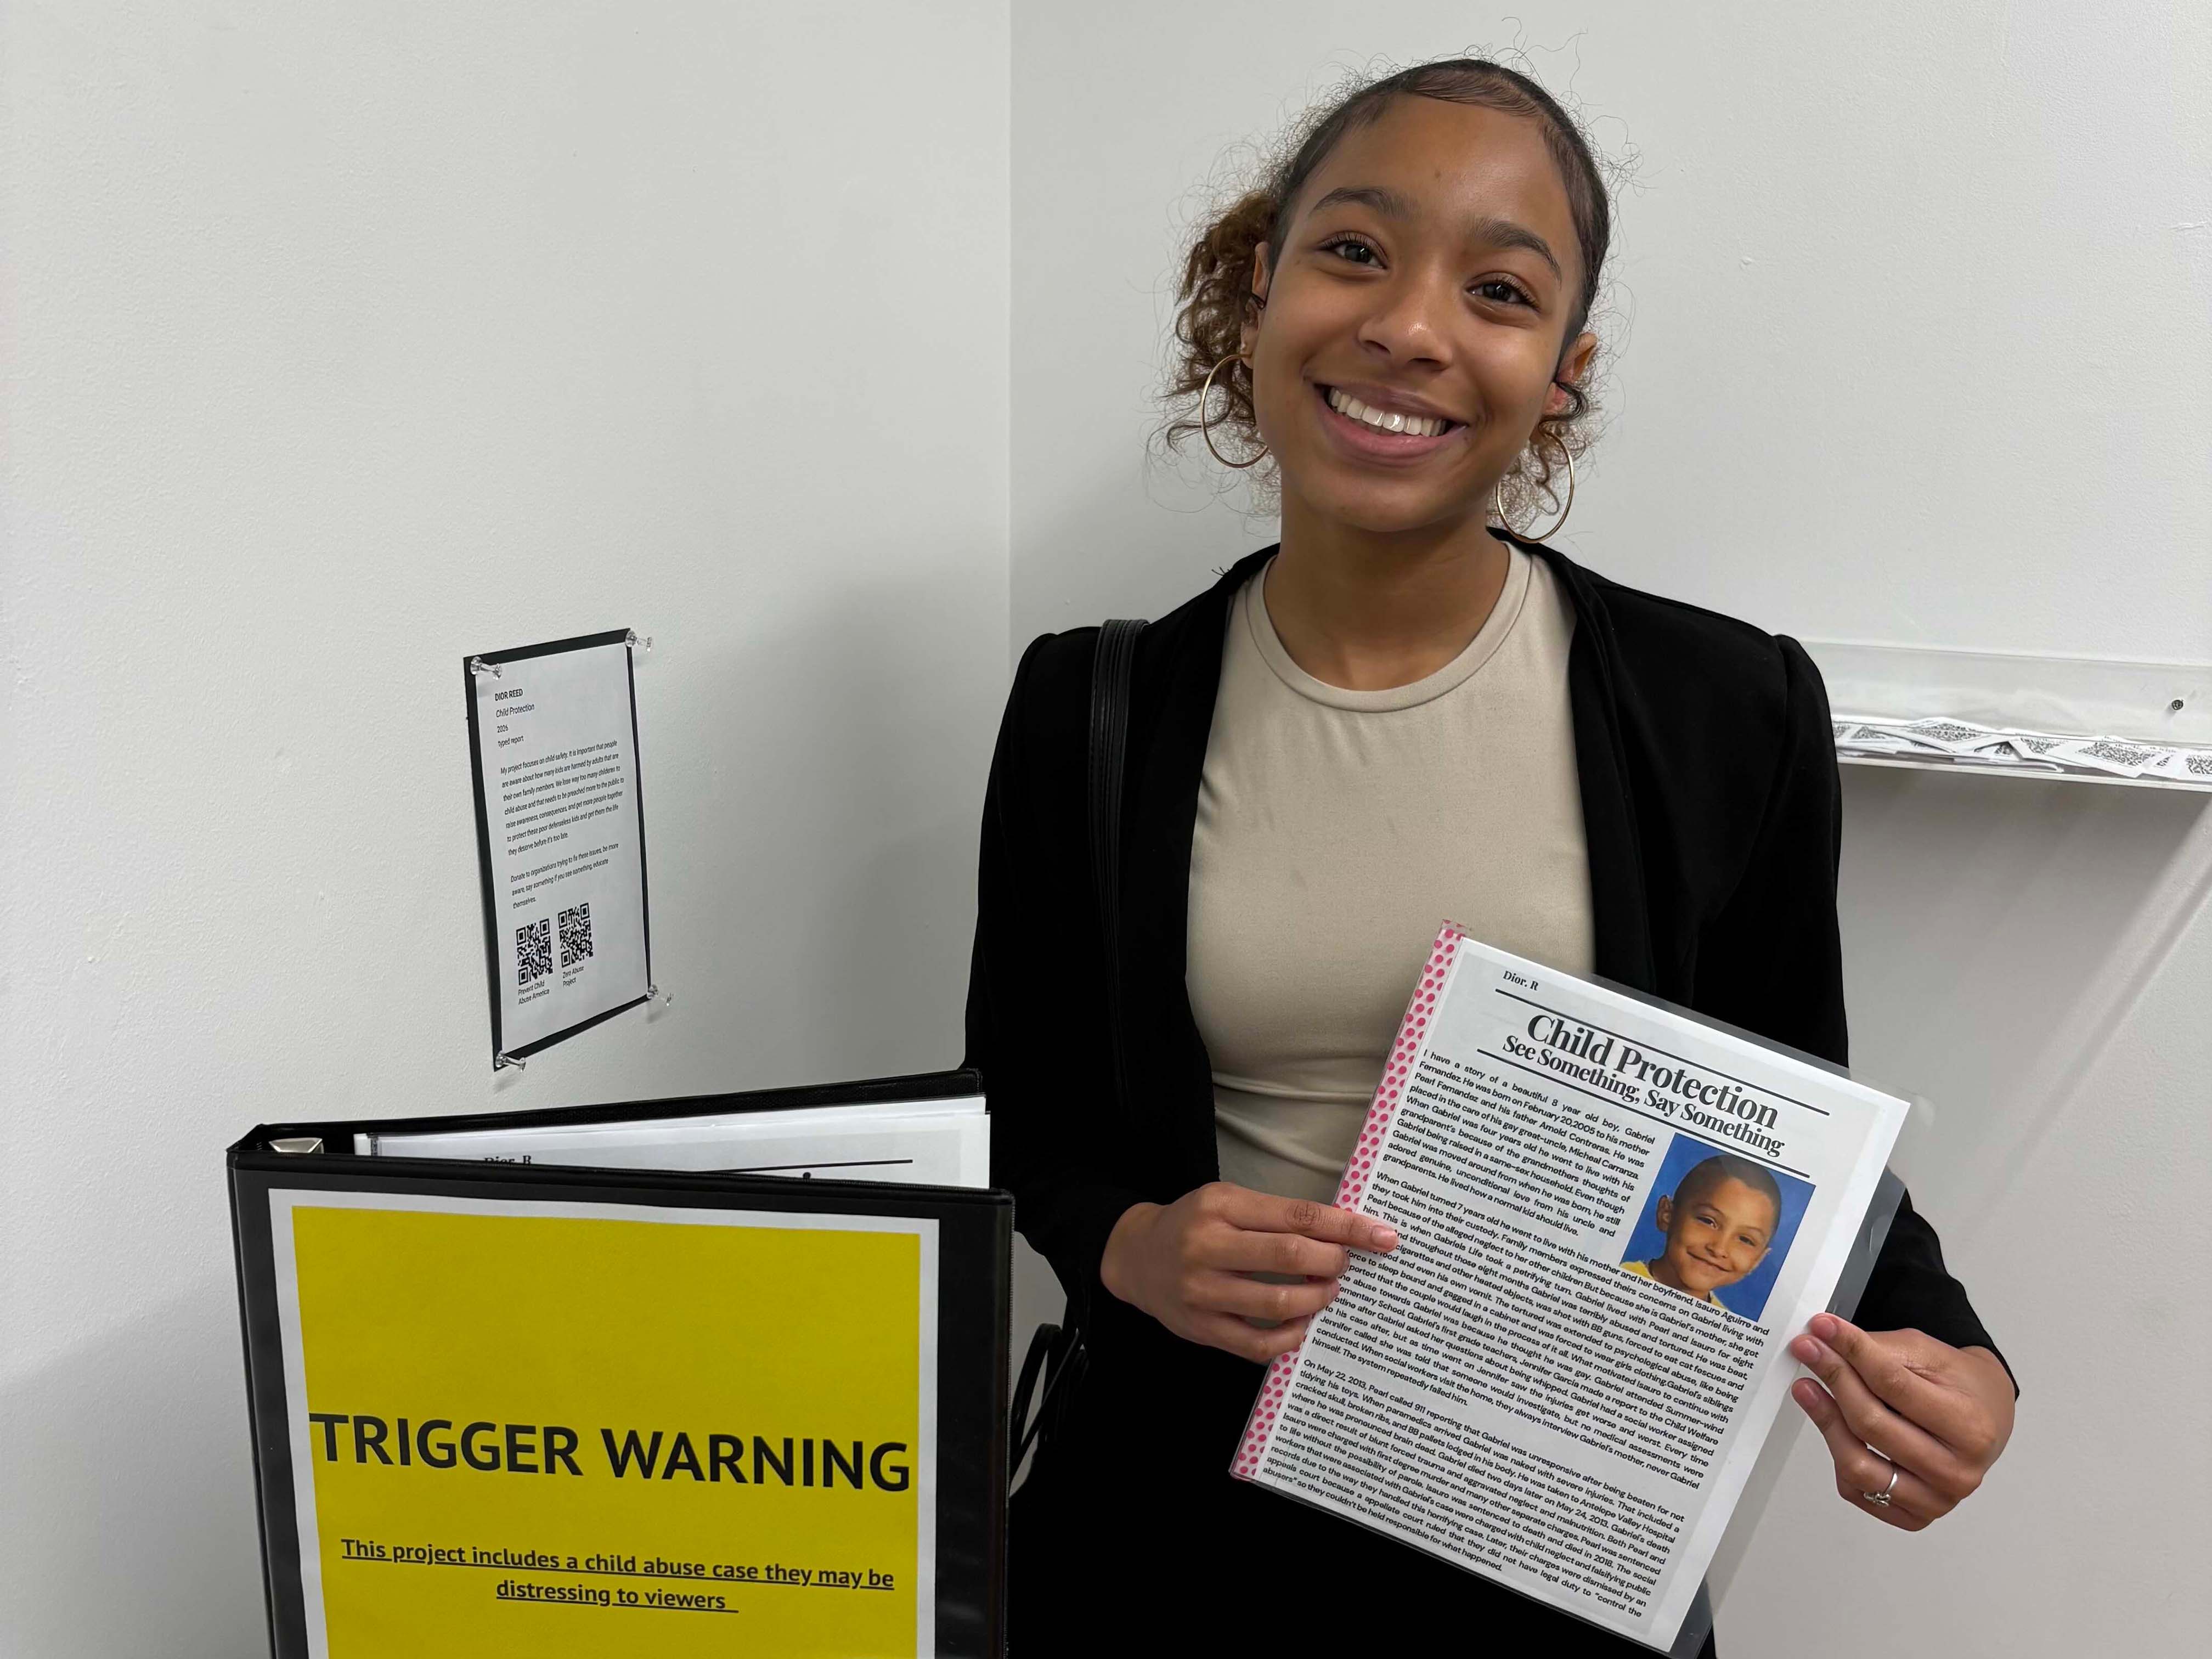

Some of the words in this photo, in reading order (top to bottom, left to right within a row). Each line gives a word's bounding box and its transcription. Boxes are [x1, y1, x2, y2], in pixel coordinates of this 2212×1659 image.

[494, 691, 509, 702] DIOR
[509, 688, 523, 698] REED
[495, 707, 509, 718] Child
[509, 703, 535, 715] Protection
[498, 737, 511, 749] typed
[510, 735, 524, 745] report
[500, 766, 507, 776] My
[507, 763, 522, 774] project
[522, 759, 539, 769] focuses
[545, 753, 555, 764] child
[576, 745, 596, 755] important
[596, 743, 604, 751] that
[603, 740, 618, 750] people
[504, 805, 515, 815] child
[515, 804, 528, 812] abuse
[528, 799, 536, 809] and
[536, 798, 545, 806] that
[544, 794, 557, 804] needs
[585, 785, 596, 793] more
[607, 777, 620, 788] public
[507, 848, 517, 856] they
[517, 843, 534, 853] deserve
[533, 838, 547, 848] before
[518, 985, 534, 996] Prevent
[534, 979, 545, 990] Child
[563, 977, 577, 988] Project
[572, 966, 584, 974] Abuse
[1503, 969, 1527, 988] Dior.
[1530, 980, 1539, 991] R
[518, 996, 532, 1005] Abuse
[532, 989, 550, 1000] America
[1527, 1014, 1615, 1067] Child
[1617, 1045, 1779, 1130] Protection
[1419, 1060, 1462, 1083] Fernandez.
[1462, 1077, 1475, 1087] He
[1475, 1083, 1492, 1094] was
[1491, 1088, 1511, 1102] born
[1511, 1098, 1523, 1107] on
[1522, 1101, 1561, 1122] February
[1559, 1115, 1596, 1135] 20,2005
[1596, 1130, 1605, 1139] to
[1605, 1133, 1619, 1144] his
[1618, 1140, 1650, 1156] mother
[1423, 1048, 1428, 1057] I
[1430, 1051, 1451, 1065] have
[1464, 1066, 1486, 1080] story
[1489, 1076, 1499, 1084] of
[1511, 1083, 1549, 1103] beautiful
[1551, 1098, 1559, 1107] 8
[1561, 1104, 1582, 1115] year
[1584, 1113, 1599, 1123] old
[1601, 1118, 1620, 1132] boy,
[1624, 1127, 1656, 1145] Gabriel
[1502, 1035, 1537, 1061] See
[1537, 1047, 1641, 1105] Something,
[1644, 1089, 1680, 1117] Say
[1680, 1103, 1785, 1158] Something
[1414, 1072, 1436, 1086] Pearl
[1436, 1080, 1479, 1103] Fernandez
[1480, 1099, 1497, 1110] and
[1498, 1104, 1511, 1115] his
[1513, 1110, 1538, 1126] father
[1538, 1121, 1567, 1137] Arnold
[1569, 1132, 1611, 1155] Contreras.
[1612, 1149, 1626, 1160] He
[1628, 1156, 1645, 1168] was
[1312, 1336, 1341, 1354] himself.
[1343, 1348, 1357, 1360] The
[1357, 1356, 1386, 1372] system
[1386, 1368, 1430, 1391] repeatedly
[1429, 1384, 1452, 1399] failed
[1451, 1392, 1468, 1406] him.
[309, 1413, 584, 1476] TRIGGER
[601, 1427, 910, 1492] WARNING
[1304, 1359, 1316, 1369] On
[1317, 1363, 1335, 1377] May
[1334, 1371, 1346, 1382] 22,
[1347, 1376, 1367, 1390] 2013,
[1368, 1384, 1389, 1398] Pearl
[1389, 1395, 1414, 1408] called
[1414, 1403, 1426, 1414] 911
[1426, 1410, 1463, 1431] reporting
[1463, 1425, 1481, 1437] that
[1481, 1432, 1511, 1449] Gabriel
[1511, 1445, 1527, 1457] was
[1528, 1453, 1582, 1479] unresponsive
[1582, 1475, 1603, 1487] after
[1602, 1482, 1627, 1499] being
[1626, 1492, 1656, 1510] beaten
[1657, 1505, 1670, 1515] for
[1669, 1512, 1685, 1522] not
[1307, 1483, 1325, 1497] they
[1325, 1492, 1357, 1509] couldn't
[1356, 1503, 1368, 1513] be
[1367, 1508, 1386, 1521] held
[1385, 1517, 1430, 1539] responsible
[1429, 1534, 1442, 1544] for
[1442, 1541, 1462, 1554] what
[1461, 1548, 1502, 1572] happened.
[341, 1538, 386, 1558] This
[393, 1544, 466, 1565] project
[472, 1546, 560, 1569] includes
[566, 1553, 578, 1570] a
[585, 1554, 636, 1573] child
[644, 1557, 705, 1577] abuse
[713, 1563, 758, 1579] case
[765, 1564, 812, 1587] they
[819, 1570, 863, 1589] may
[868, 1568, 895, 1587] be
[496, 1579, 610, 1606] distressing
[617, 1588, 639, 1605] to
[645, 1589, 726, 1610] viewers
